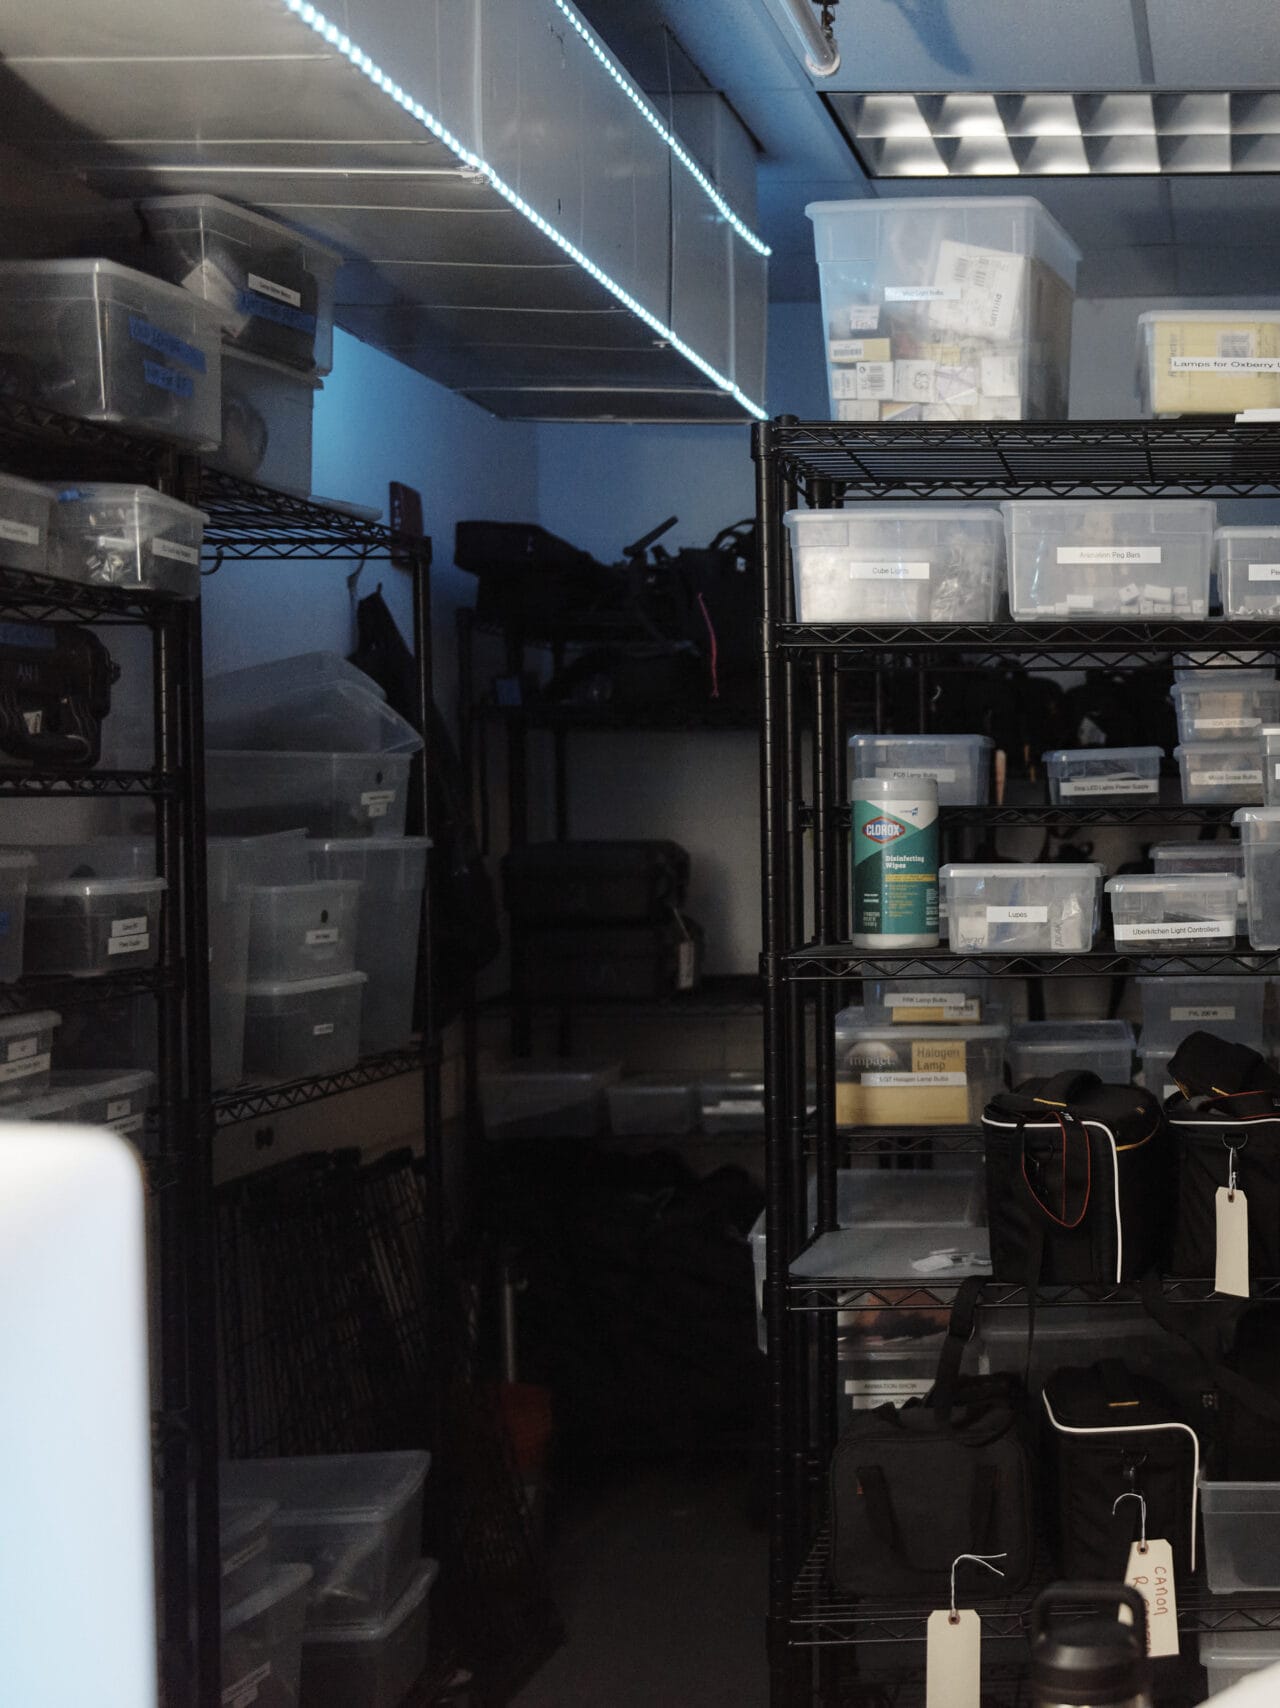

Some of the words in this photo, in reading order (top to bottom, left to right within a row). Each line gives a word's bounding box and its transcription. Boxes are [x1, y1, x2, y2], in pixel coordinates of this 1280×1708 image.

[1173, 360, 1210, 370] Lamps
[1213, 360, 1228, 368] for
[1230, 360, 1274, 371] Oxberry
[866, 824, 900, 836] CLOROX
[885, 855, 924, 864] Disinfecting
[1008, 912, 1028, 920] Lupes
[1170, 926, 1185, 936] Light
[1186, 926, 1220, 934] Controllers
[916, 1047, 960, 1059] Halogen
[916, 1059, 946, 1071] Lamp
